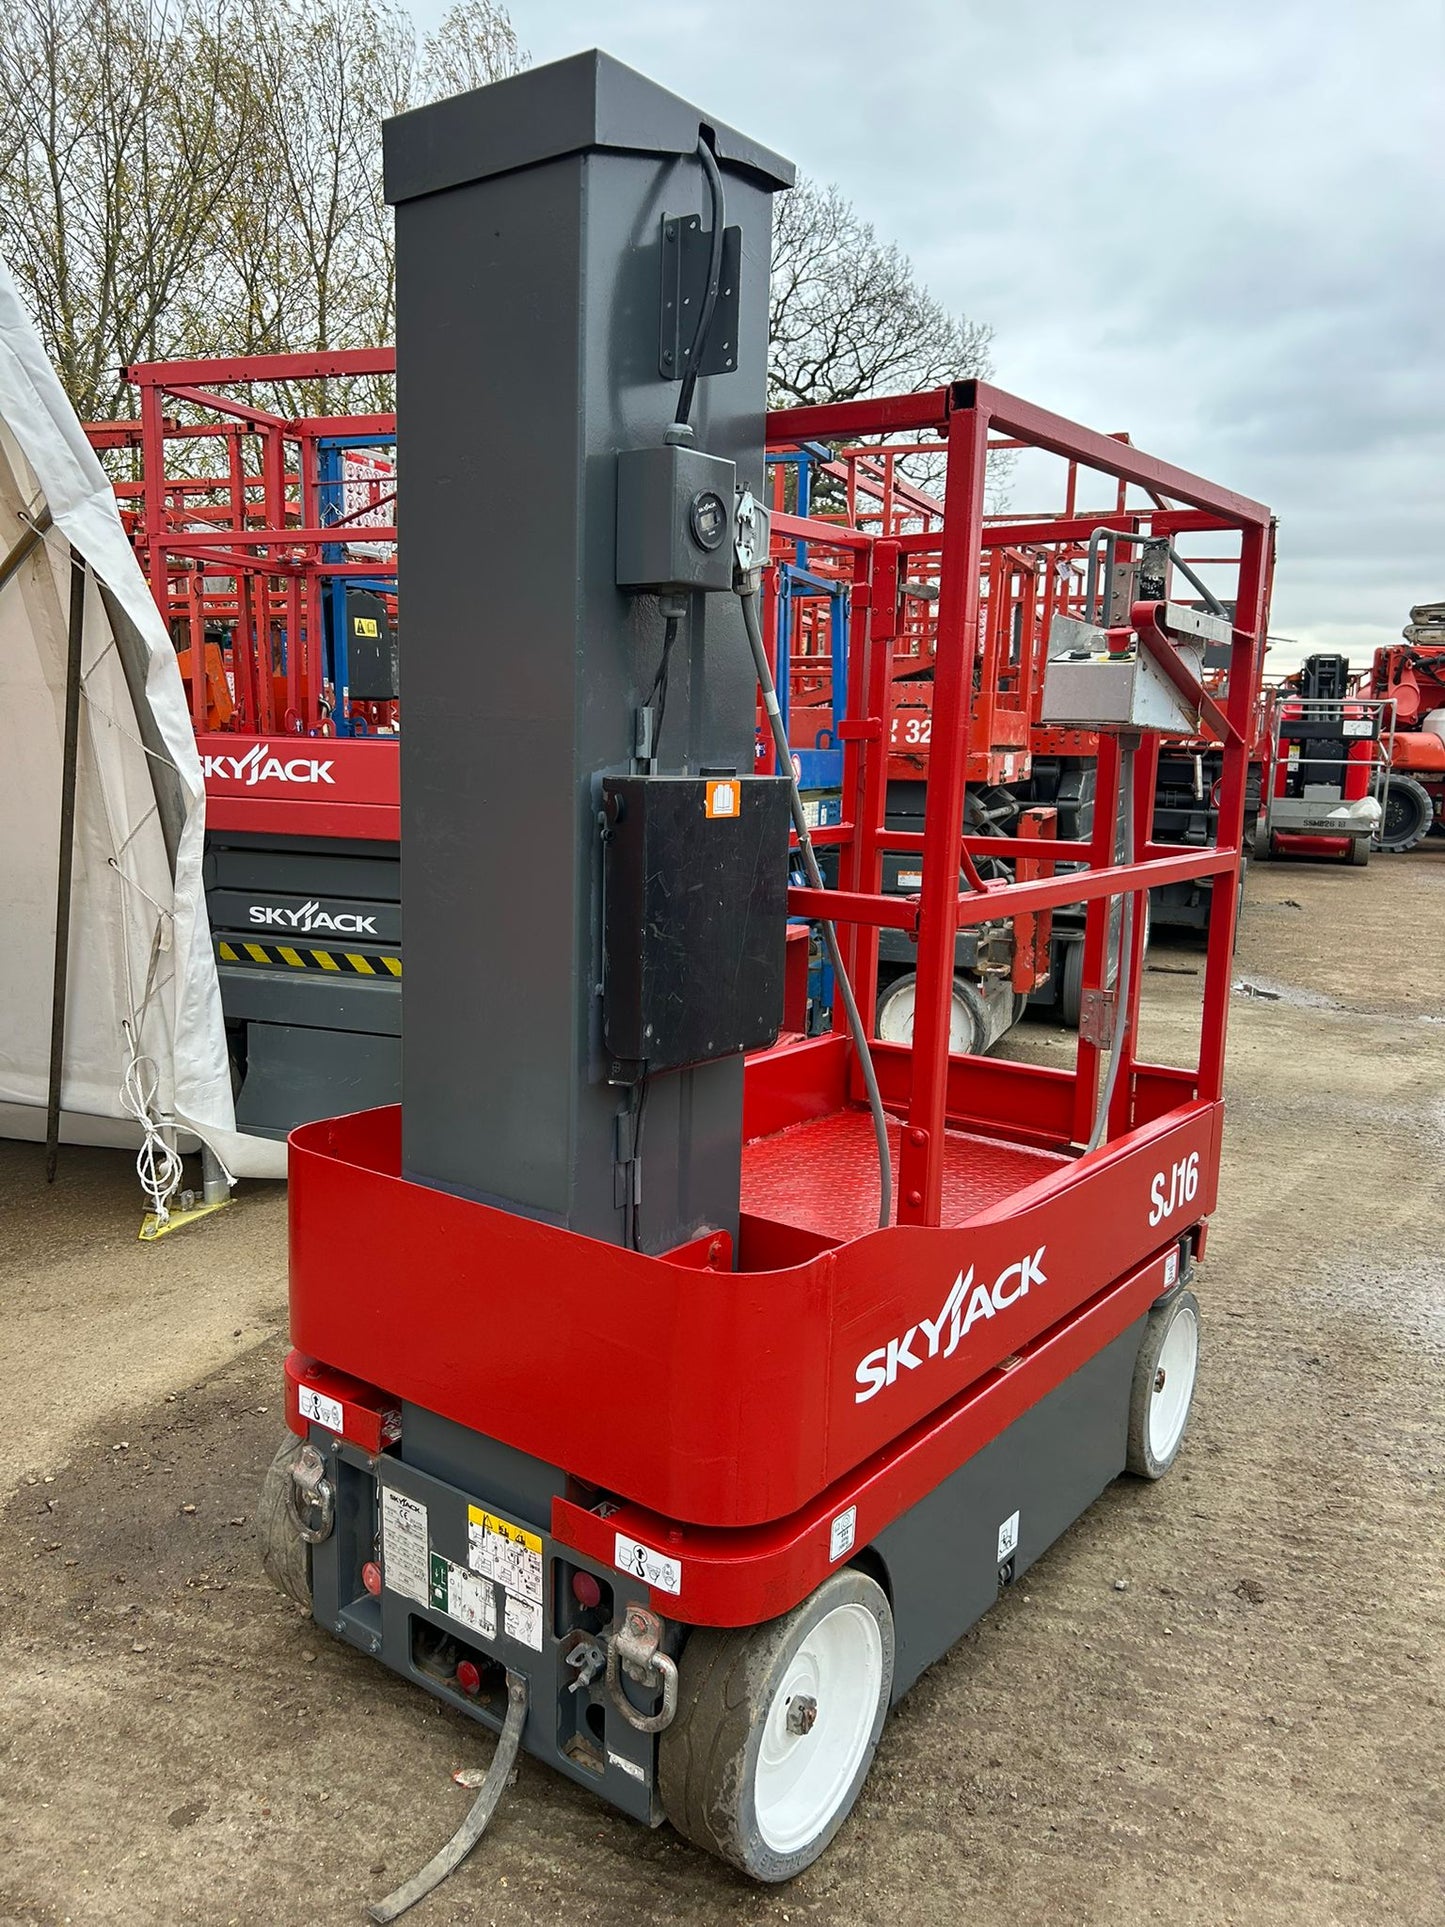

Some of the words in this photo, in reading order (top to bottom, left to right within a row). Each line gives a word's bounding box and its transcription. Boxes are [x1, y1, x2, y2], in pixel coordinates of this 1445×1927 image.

[249, 900, 378, 935] SKYJACK
[1149, 1150, 1199, 1228] SJ16
[854, 1244, 1048, 1404] SKYJACK
